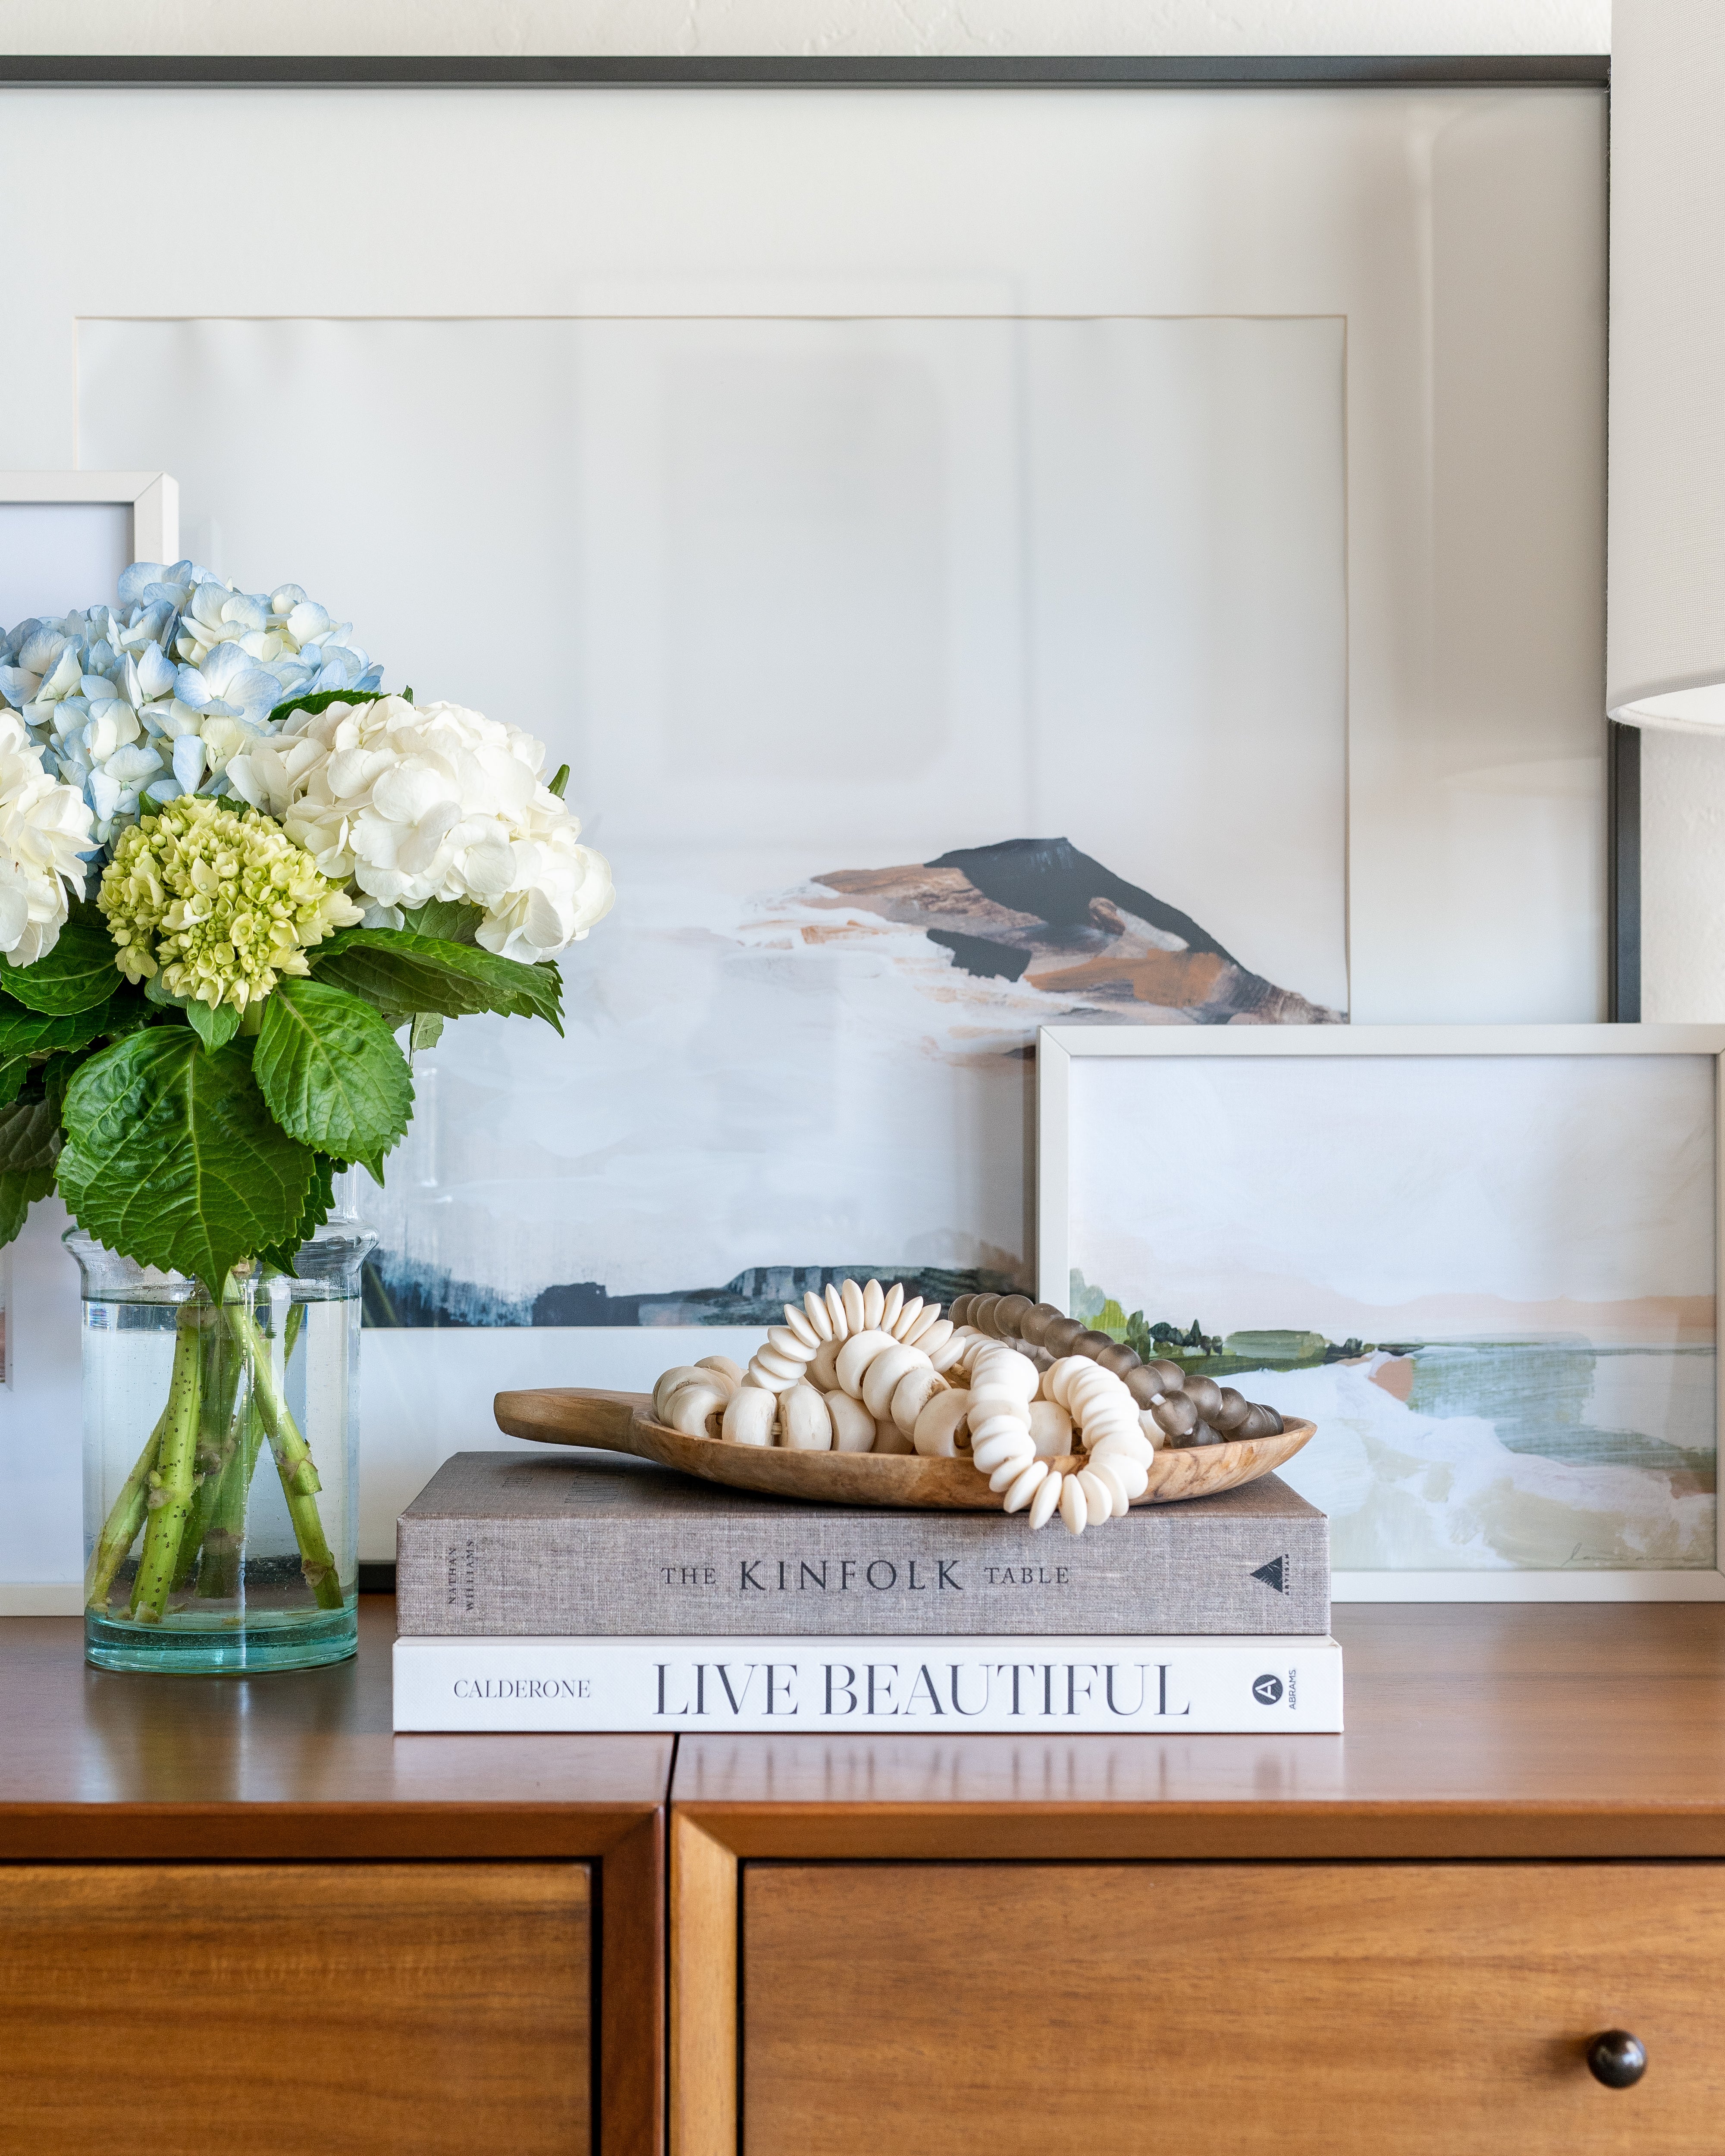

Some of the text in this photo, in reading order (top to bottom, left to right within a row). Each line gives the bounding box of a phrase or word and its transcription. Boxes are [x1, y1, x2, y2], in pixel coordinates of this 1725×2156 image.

[448, 1546, 457, 1604] NATHAN
[661, 1560, 1069, 1591] THE KINFOLK TABLE
[454, 1680, 590, 1698] CALDERONE
[652, 1664, 1190, 1716] LIVE BEAUTIFUL
